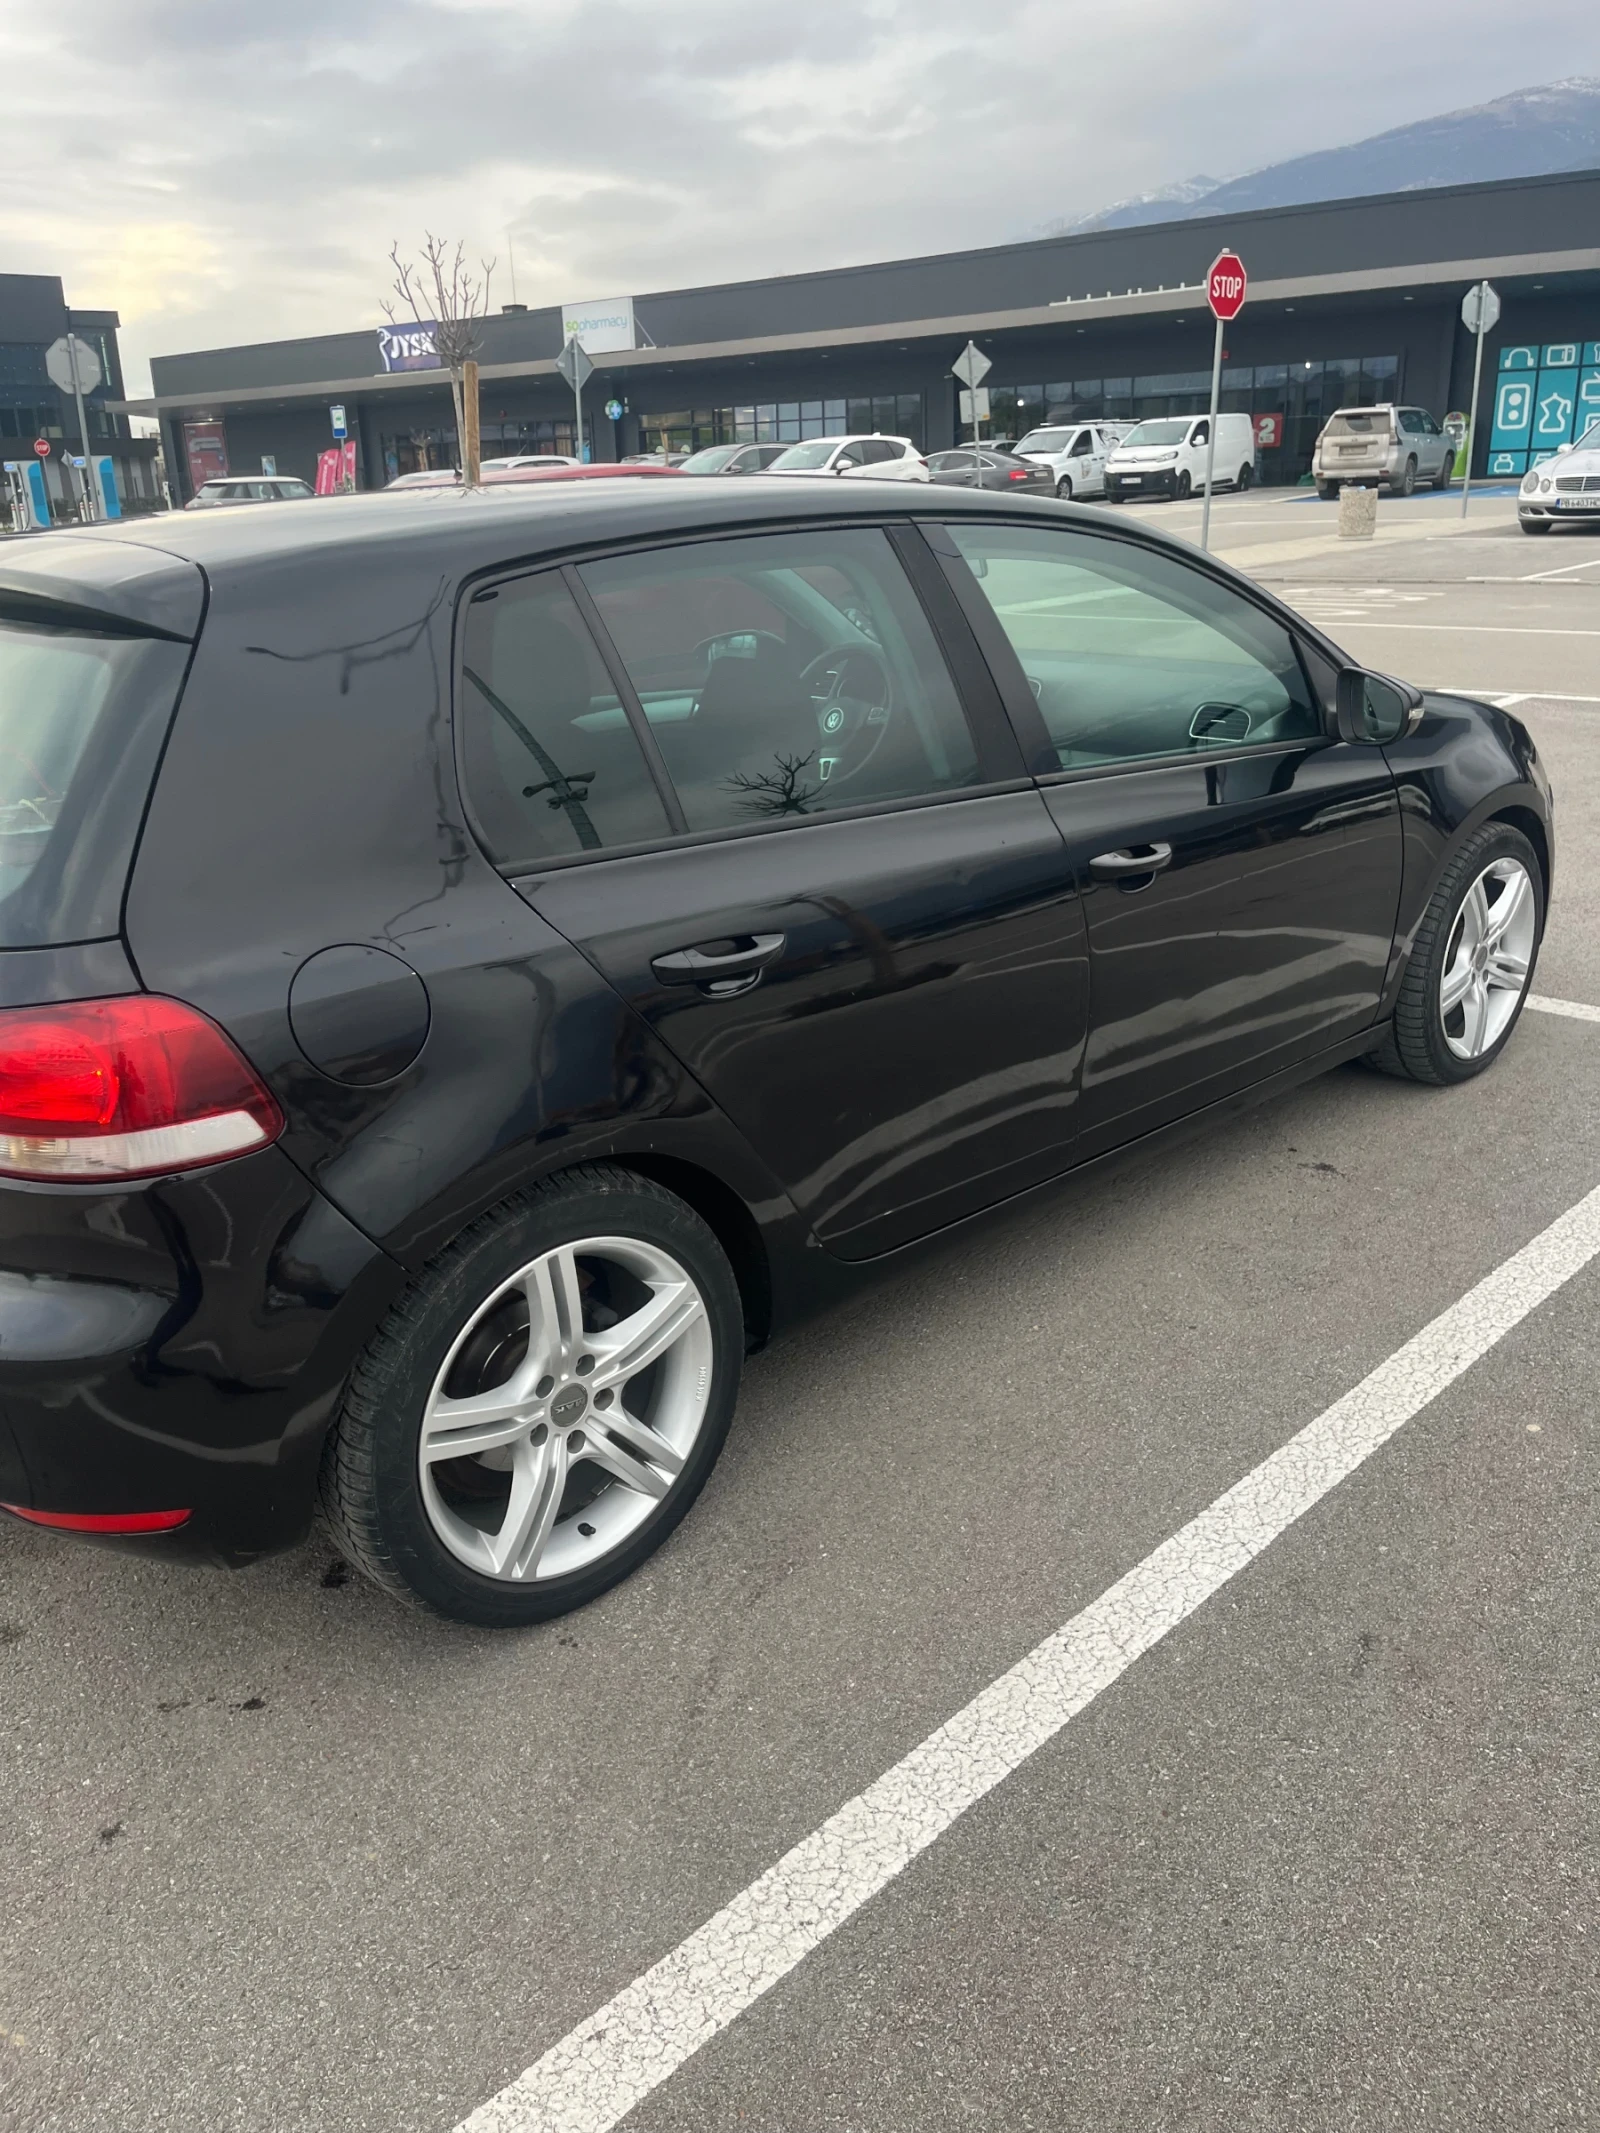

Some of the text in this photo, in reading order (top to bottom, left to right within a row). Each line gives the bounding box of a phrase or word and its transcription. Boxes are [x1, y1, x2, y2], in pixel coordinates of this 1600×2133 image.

[1212, 275, 1242, 299] STOP
[565, 317, 627, 332] sopharmacy
[391, 331, 436, 358] JYSK
[1258, 417, 1275, 443] 2
